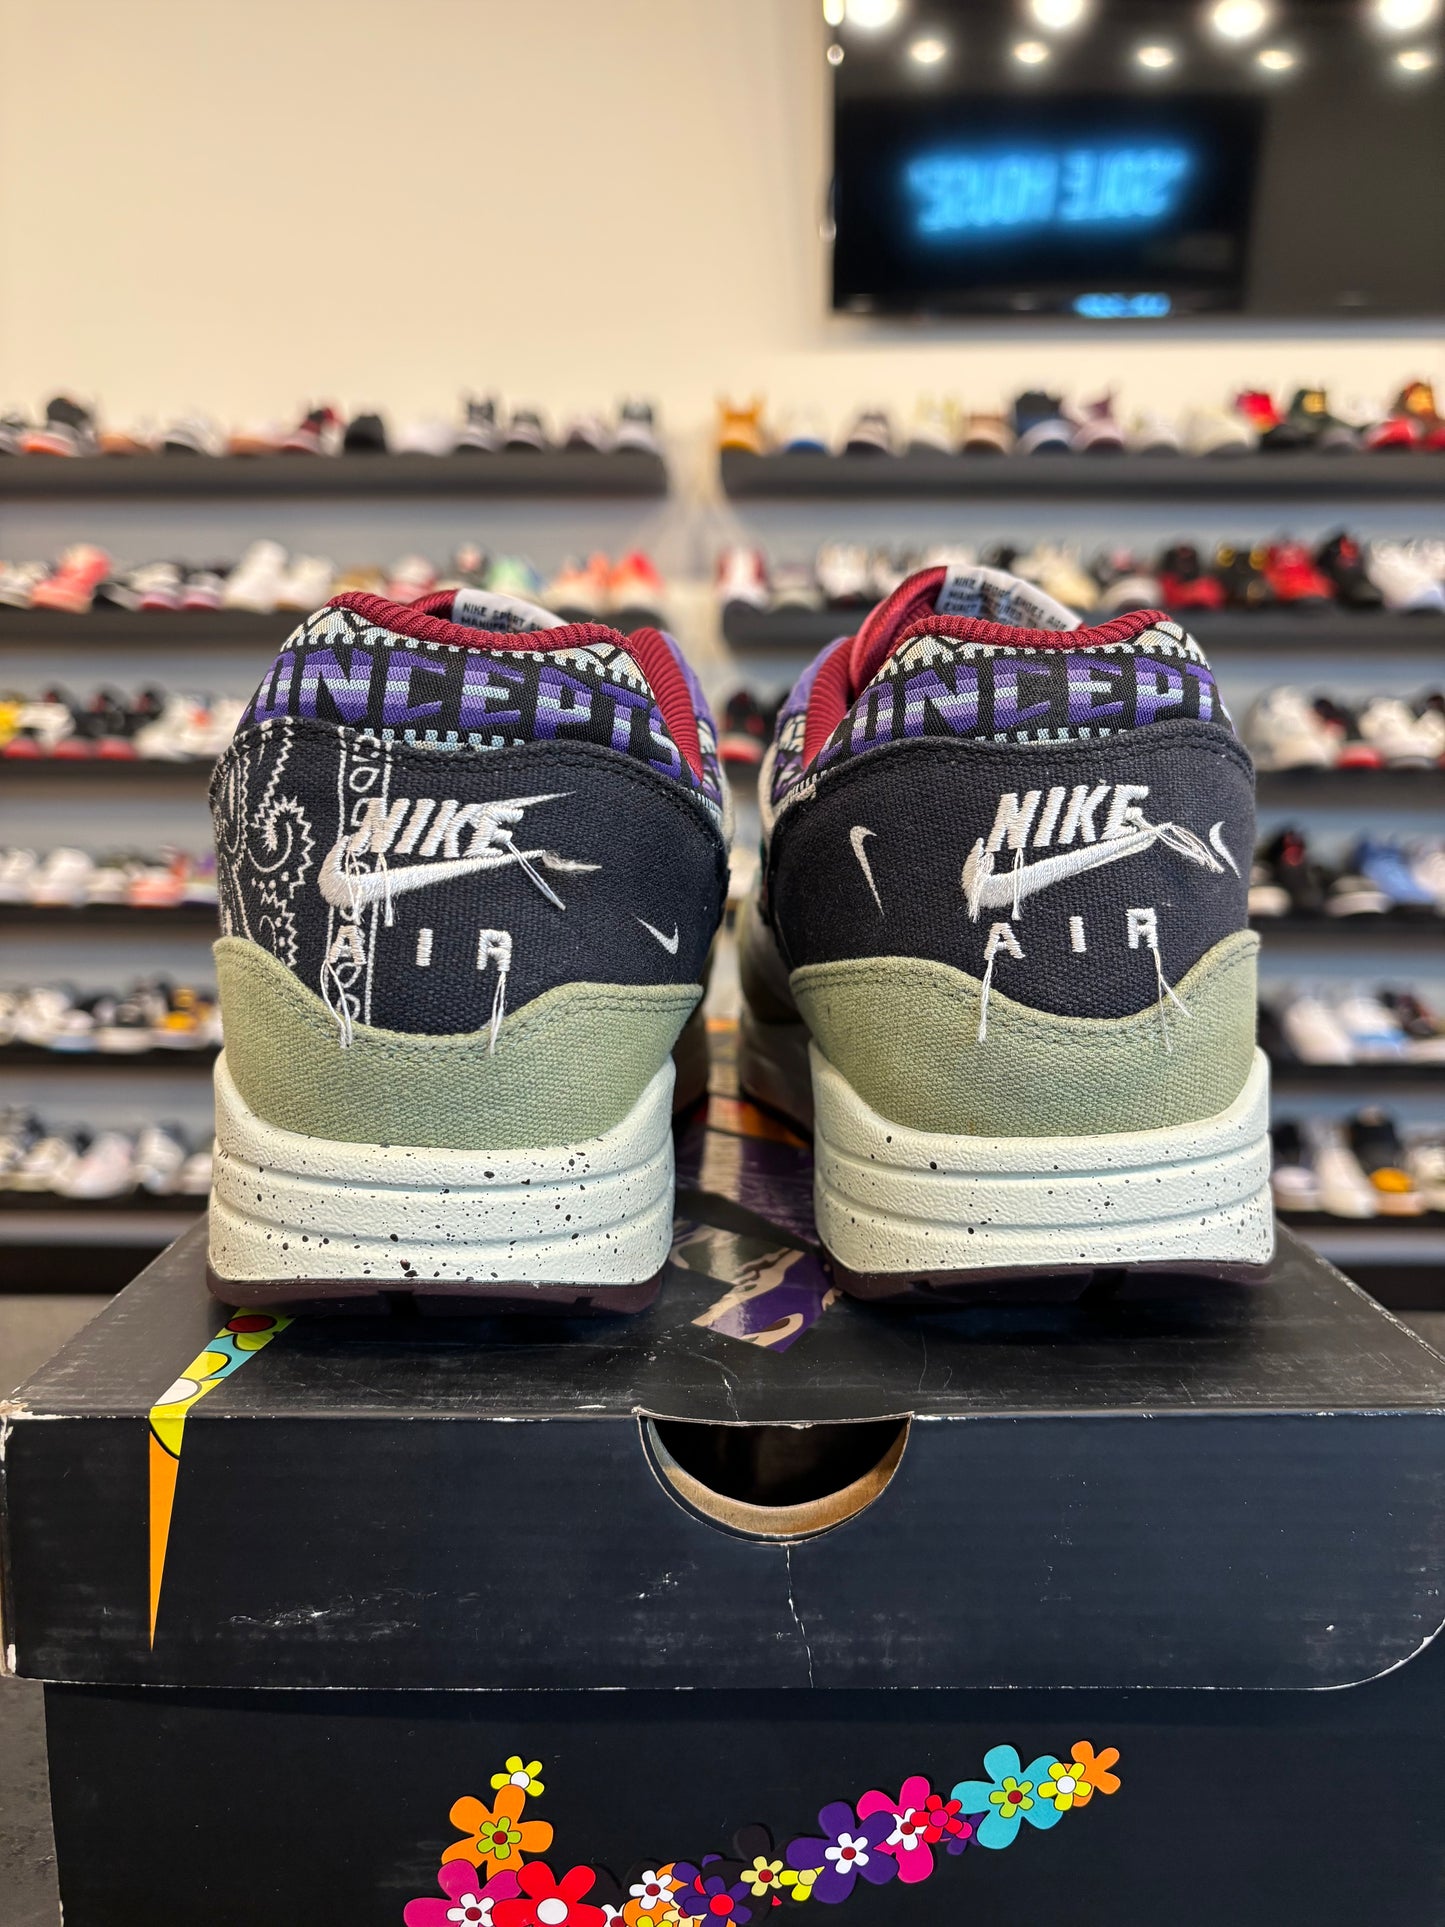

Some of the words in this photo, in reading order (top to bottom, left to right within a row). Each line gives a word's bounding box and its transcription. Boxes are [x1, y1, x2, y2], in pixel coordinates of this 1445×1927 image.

[463, 602, 487, 617] NIKE
[240, 648, 682, 781] ONCEPTS
[348, 798, 524, 858] NIKE
[984, 784, 1149, 853] NIKE
[329, 925, 513, 971] AIR
[983, 908, 1159, 960] AIR
